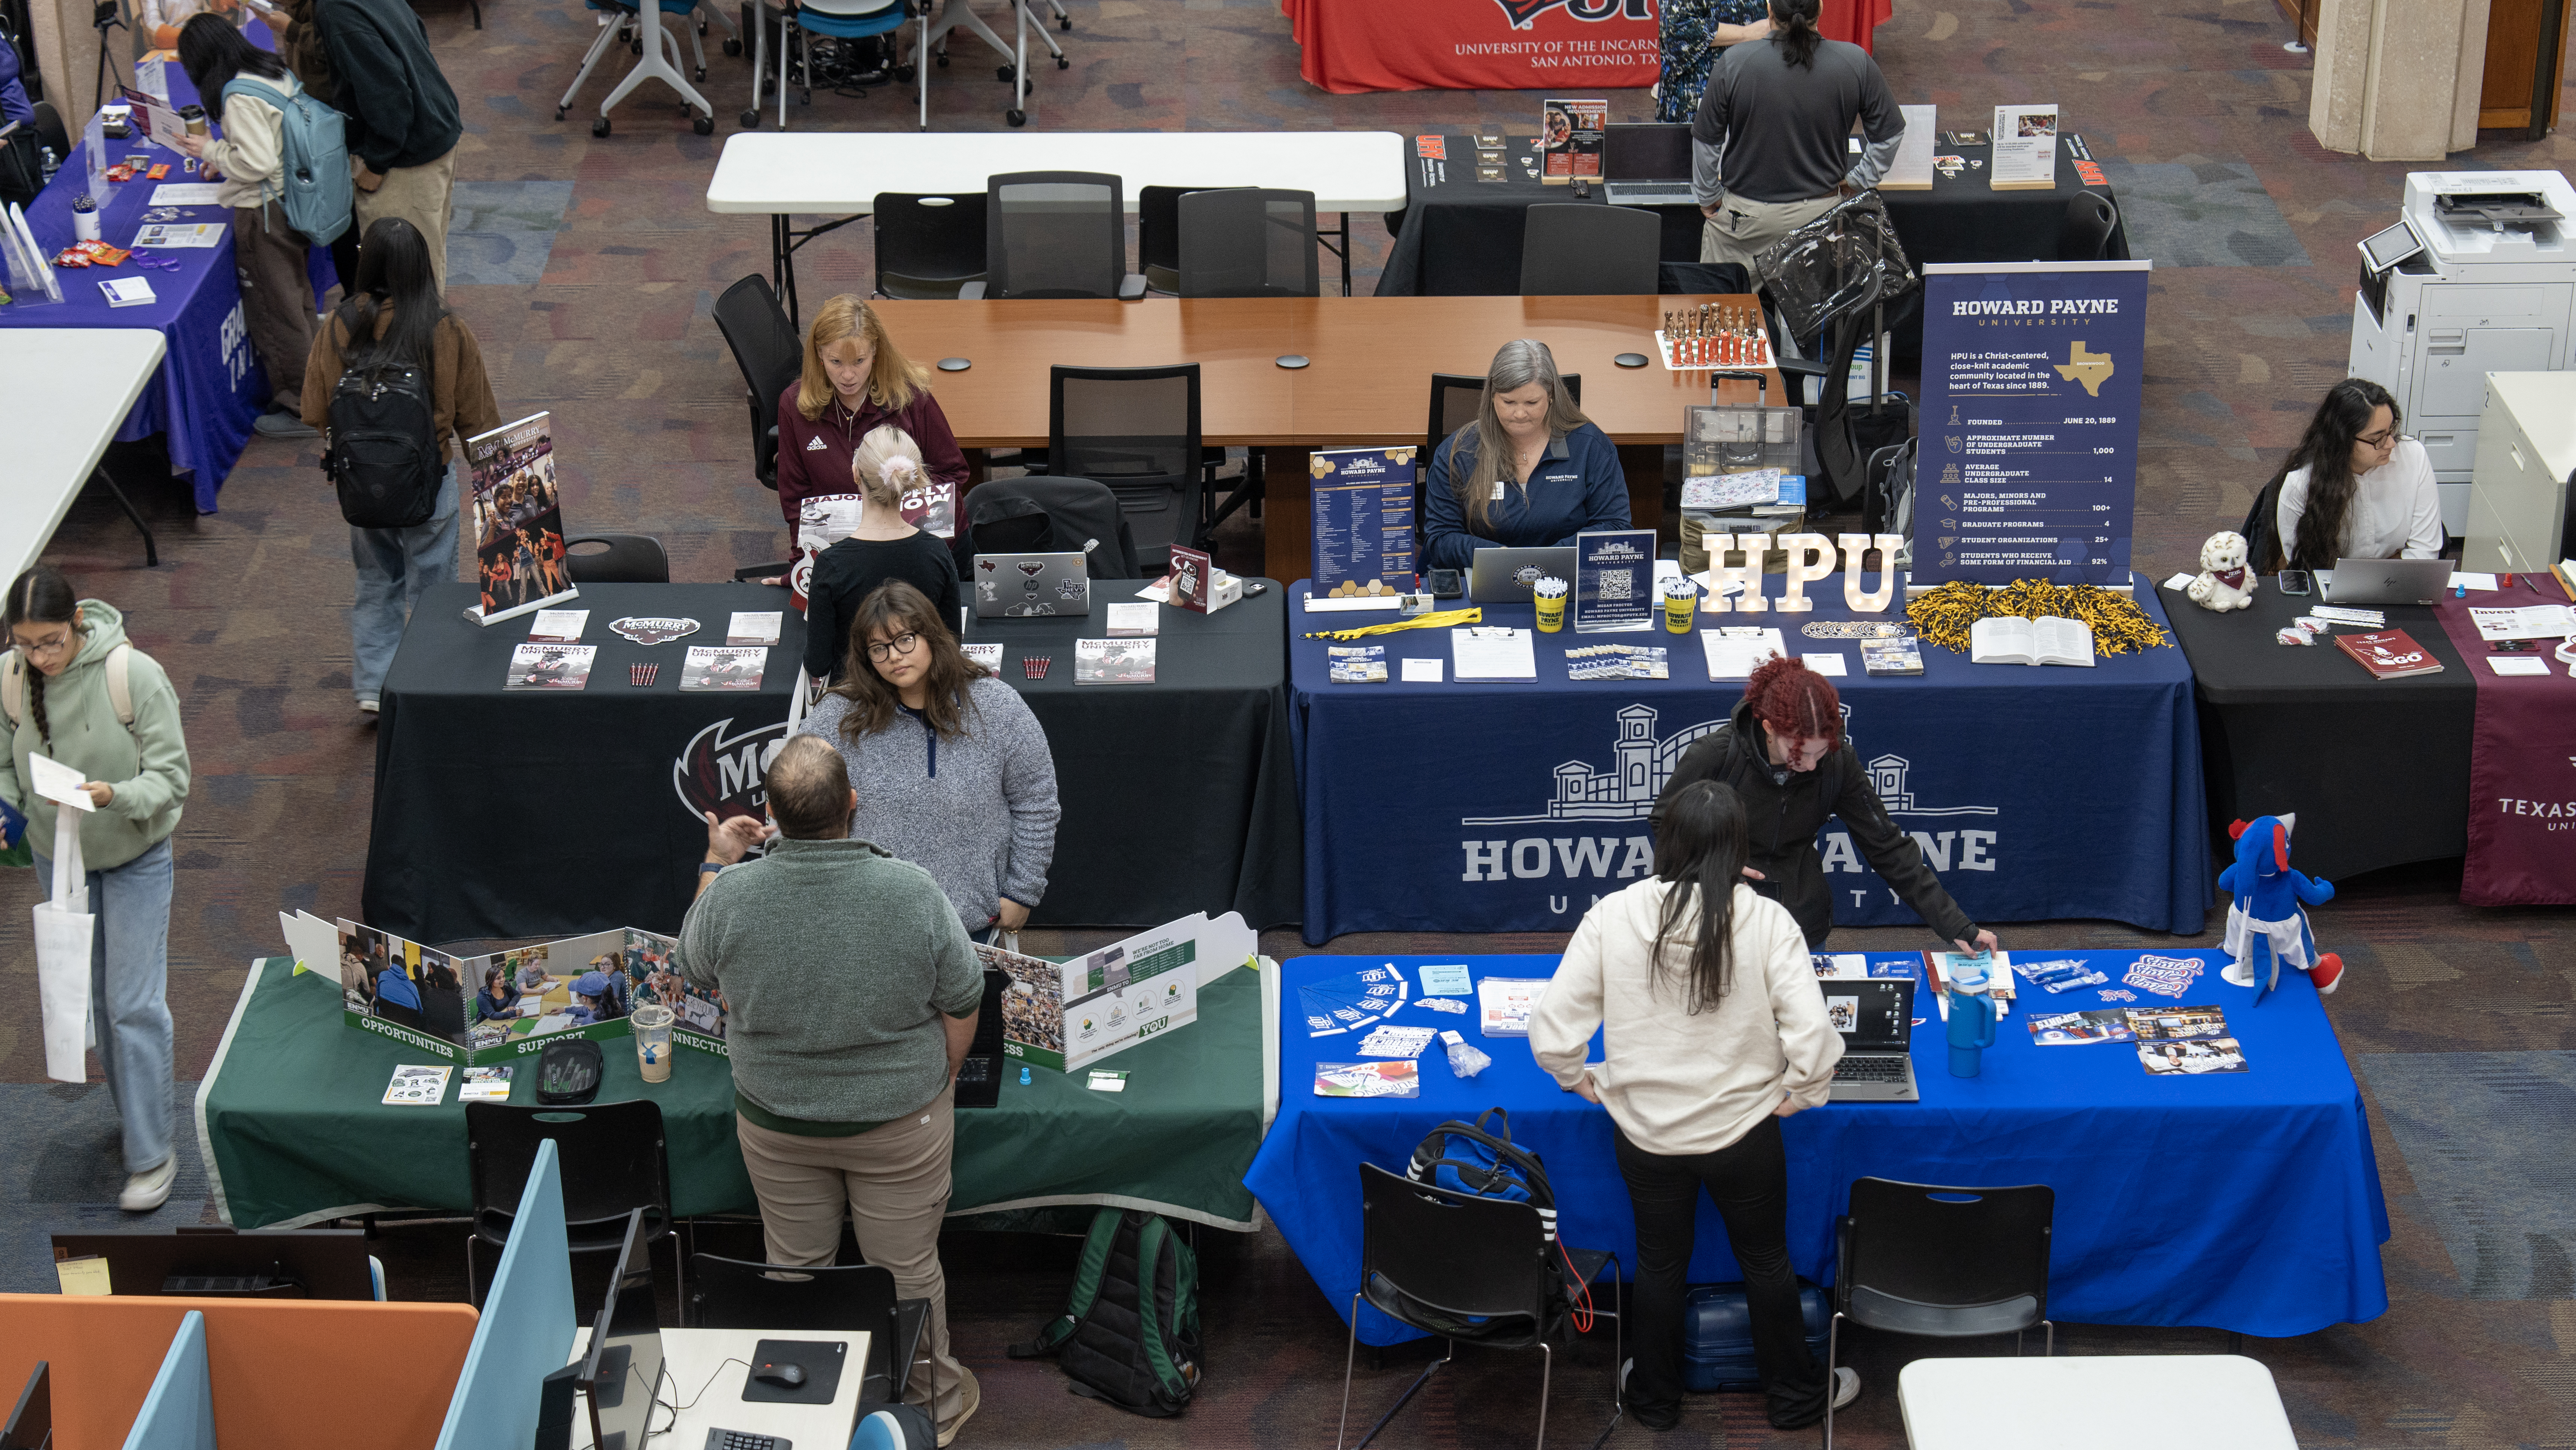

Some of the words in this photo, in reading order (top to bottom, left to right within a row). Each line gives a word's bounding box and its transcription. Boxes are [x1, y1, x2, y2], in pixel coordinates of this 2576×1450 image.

[1455, 42, 1541, 55] UNIVERSITY
[1544, 41, 1563, 53] OF
[1567, 40, 1596, 52] THE
[1601, 39, 1659, 50] INCARN
[1531, 56, 1558, 68] SAN
[1562, 54, 1635, 67] ANTONIO,
[1639, 53, 1657, 65] TX
[1953, 300, 2044, 316] HOWARD
[2050, 299, 2118, 314] PAYNE
[1985, 351, 2049, 360] Christ-centered,
[1950, 372, 1994, 380] community
[504, 426, 540, 446] McMURRY
[510, 435, 536, 448] UNIVERSITY
[1513, 565, 1531, 577] HOWARD
[1534, 566, 1546, 576] PAYNE
[1700, 533, 1904, 612] HPU
[1026, 581, 1038, 590] hp
[623, 621, 690, 631] McMURRY
[2499, 798, 2576, 817] TEXAS
[1462, 835, 1652, 882] HOWA
[1822, 830, 1997, 873] ANE
[1132, 946, 1148, 954] WE'RE
[1144, 947, 1158, 956] FROM
[1159, 941, 1174, 950] HOME
[1107, 983, 1122, 991] ENMU
[348, 1001, 369, 1014] ENMU
[1142, 1016, 1166, 1035] YOU
[2035, 1012, 2081, 1030] ESPORTS
[361, 1018, 454, 1058] OPPORTUNITIES
[1124, 1032, 1138, 1040] missing?
[2175, 1023, 2222, 1038] UNIVERSITY
[474, 1036, 505, 1048] ENMU
[1353, 1079, 1418, 1096] NURSING
